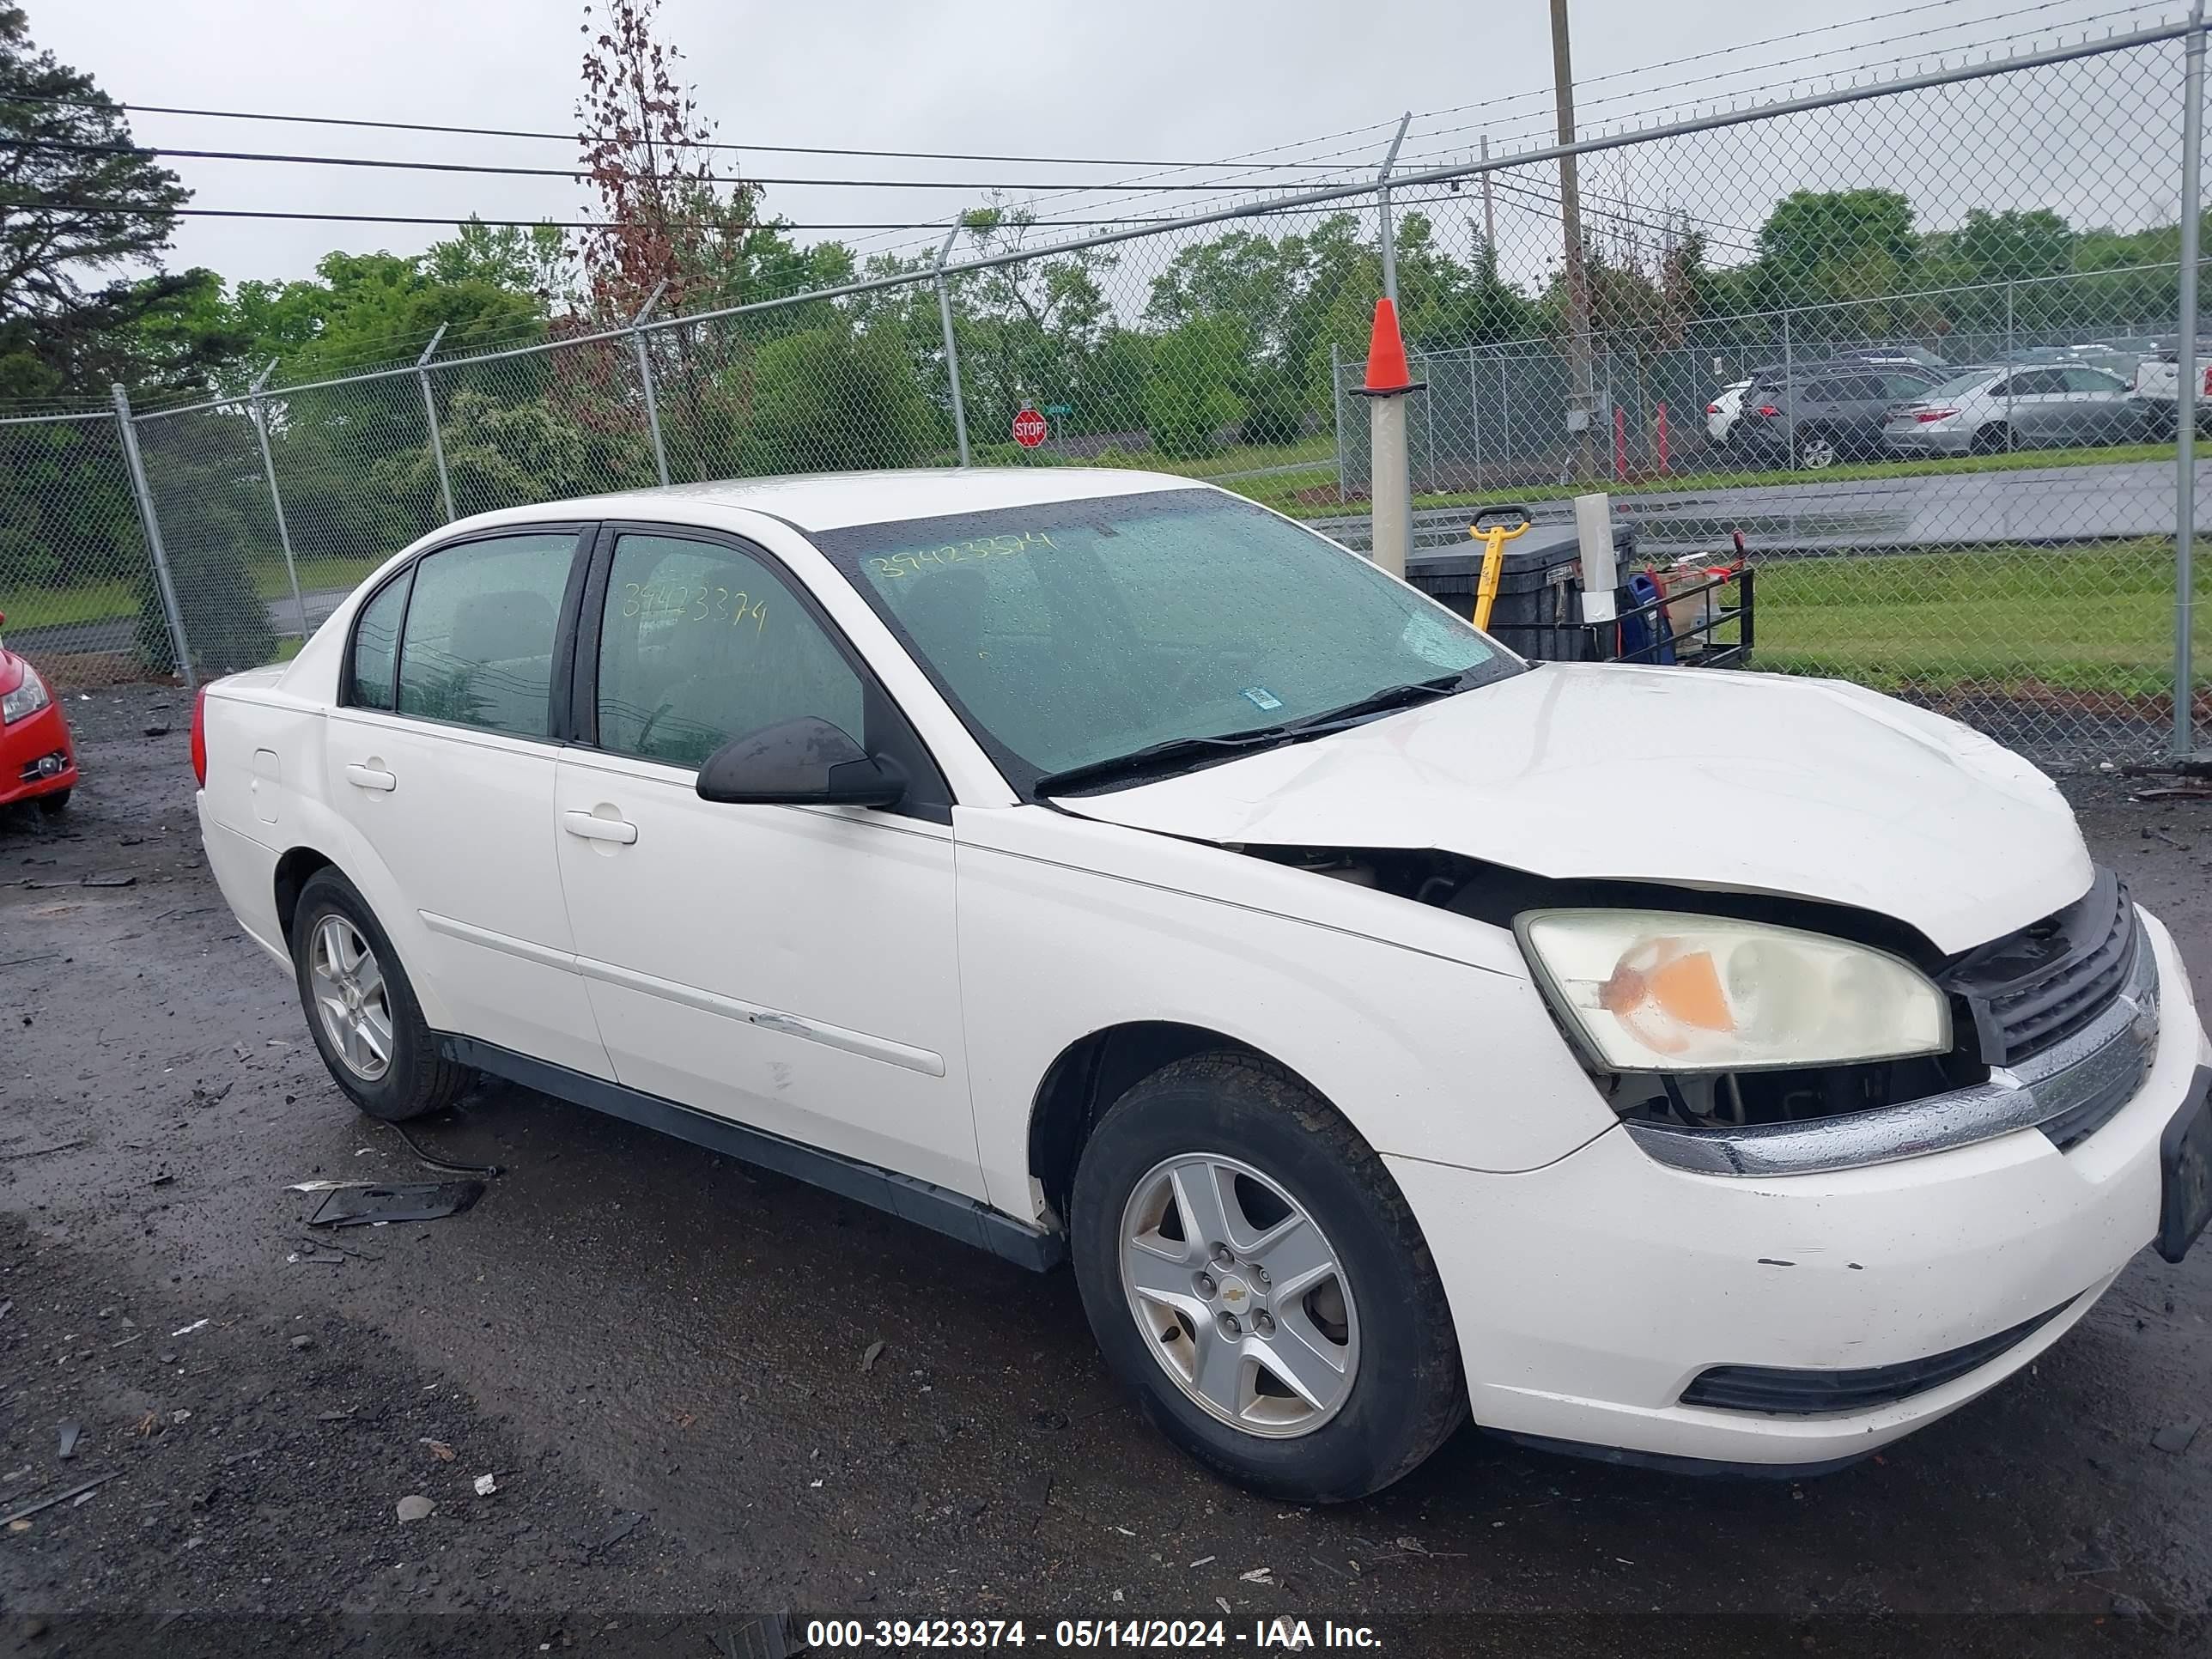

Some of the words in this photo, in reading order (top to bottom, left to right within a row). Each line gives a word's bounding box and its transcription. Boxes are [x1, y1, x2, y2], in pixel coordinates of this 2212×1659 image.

[1015, 422, 1044, 436] STOP
[869, 531, 1059, 578] 39423374
[623, 582, 768, 640] 39423374
